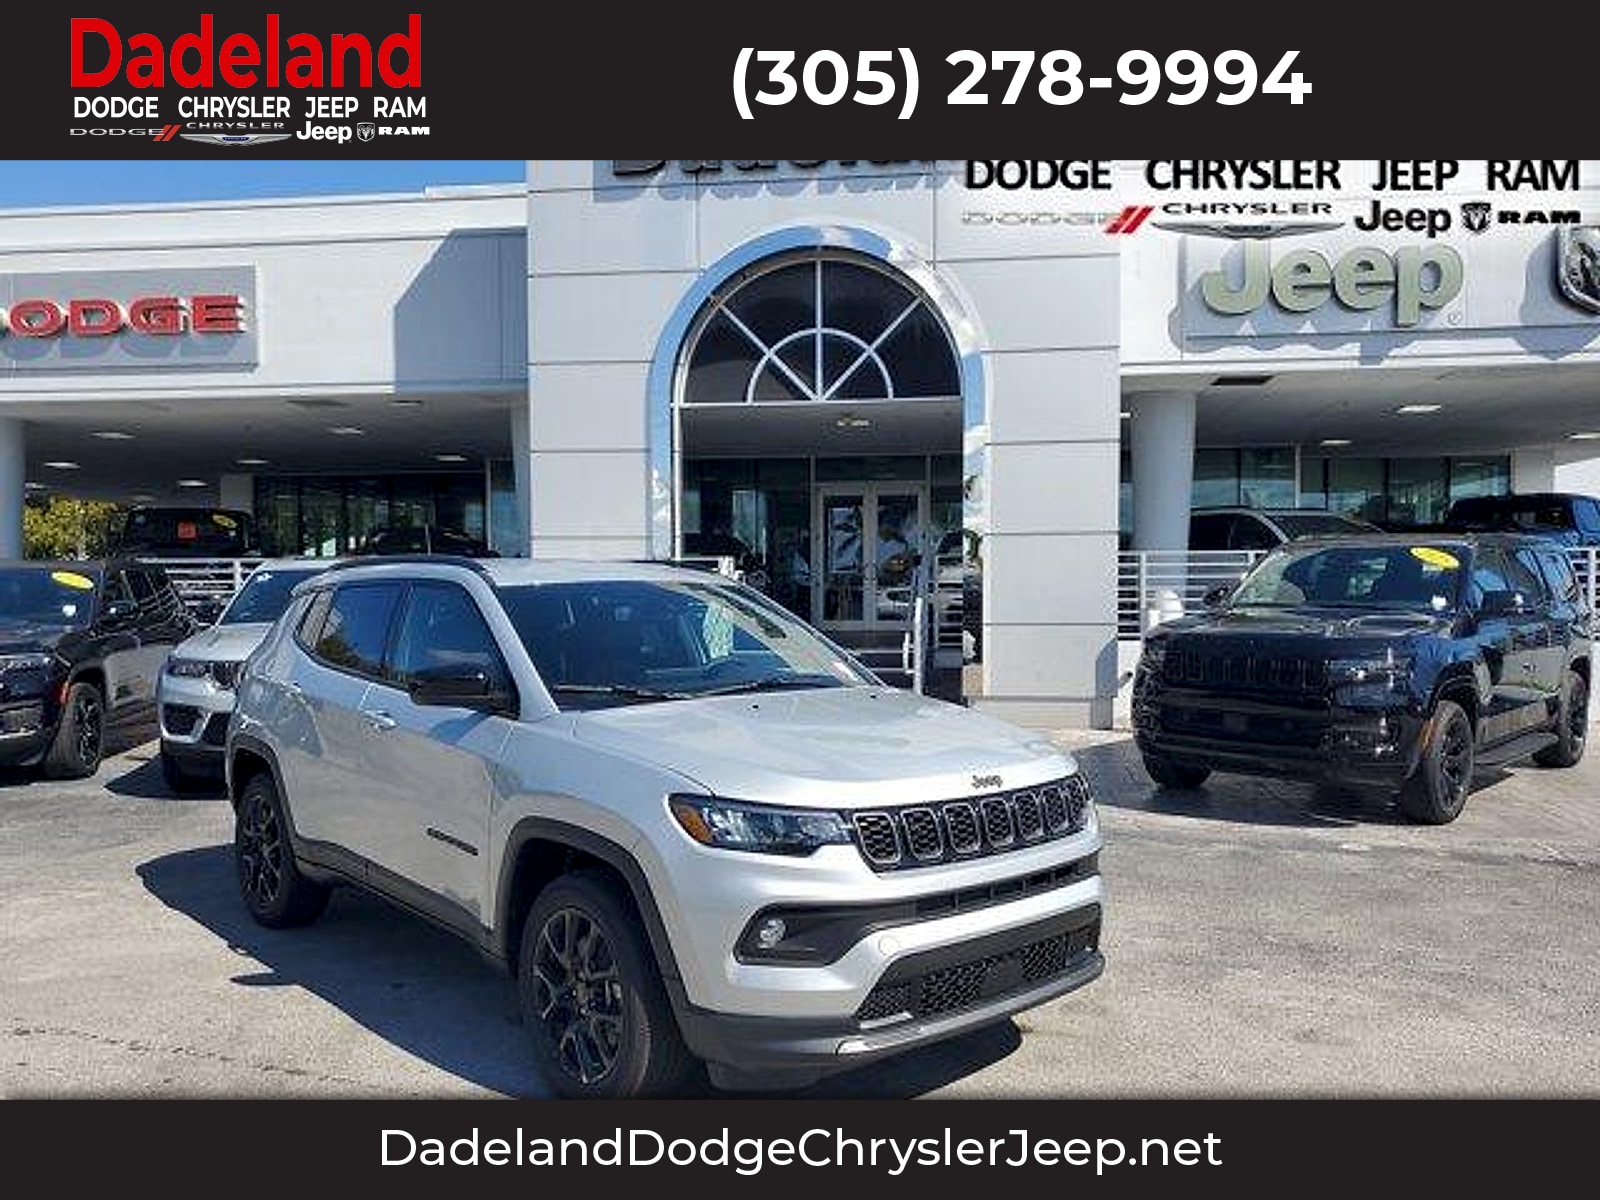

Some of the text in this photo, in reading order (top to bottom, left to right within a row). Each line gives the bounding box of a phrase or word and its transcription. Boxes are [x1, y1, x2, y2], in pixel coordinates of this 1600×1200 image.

[1202, 240, 1464, 327] Jeep
[0, 295, 240, 338] ODGE
[971, 775, 1003, 790] Jeep
